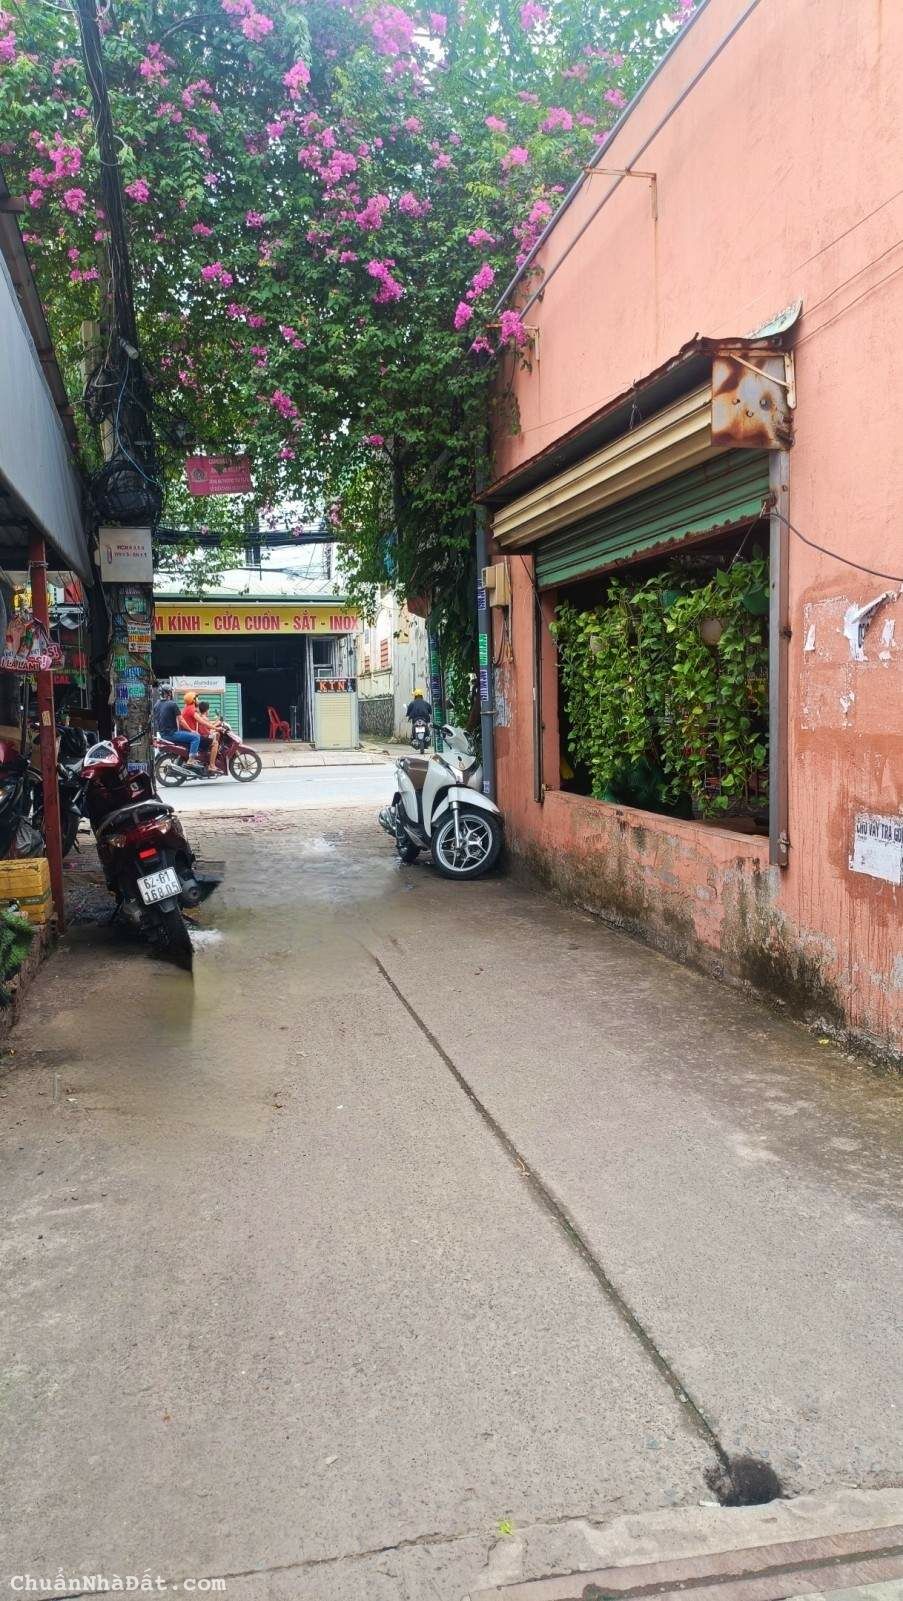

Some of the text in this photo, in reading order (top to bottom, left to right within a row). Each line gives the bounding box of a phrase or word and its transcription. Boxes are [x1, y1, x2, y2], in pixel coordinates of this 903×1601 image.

[168, 611, 201, 631] KÍNH
[214, 610, 241, 631] CỬA
[245, 609, 280, 631] CUỐN
[293, 609, 317, 630] SẮT
[329, 615, 359, 630] INOX
[869, 821, 879, 838] VAY
